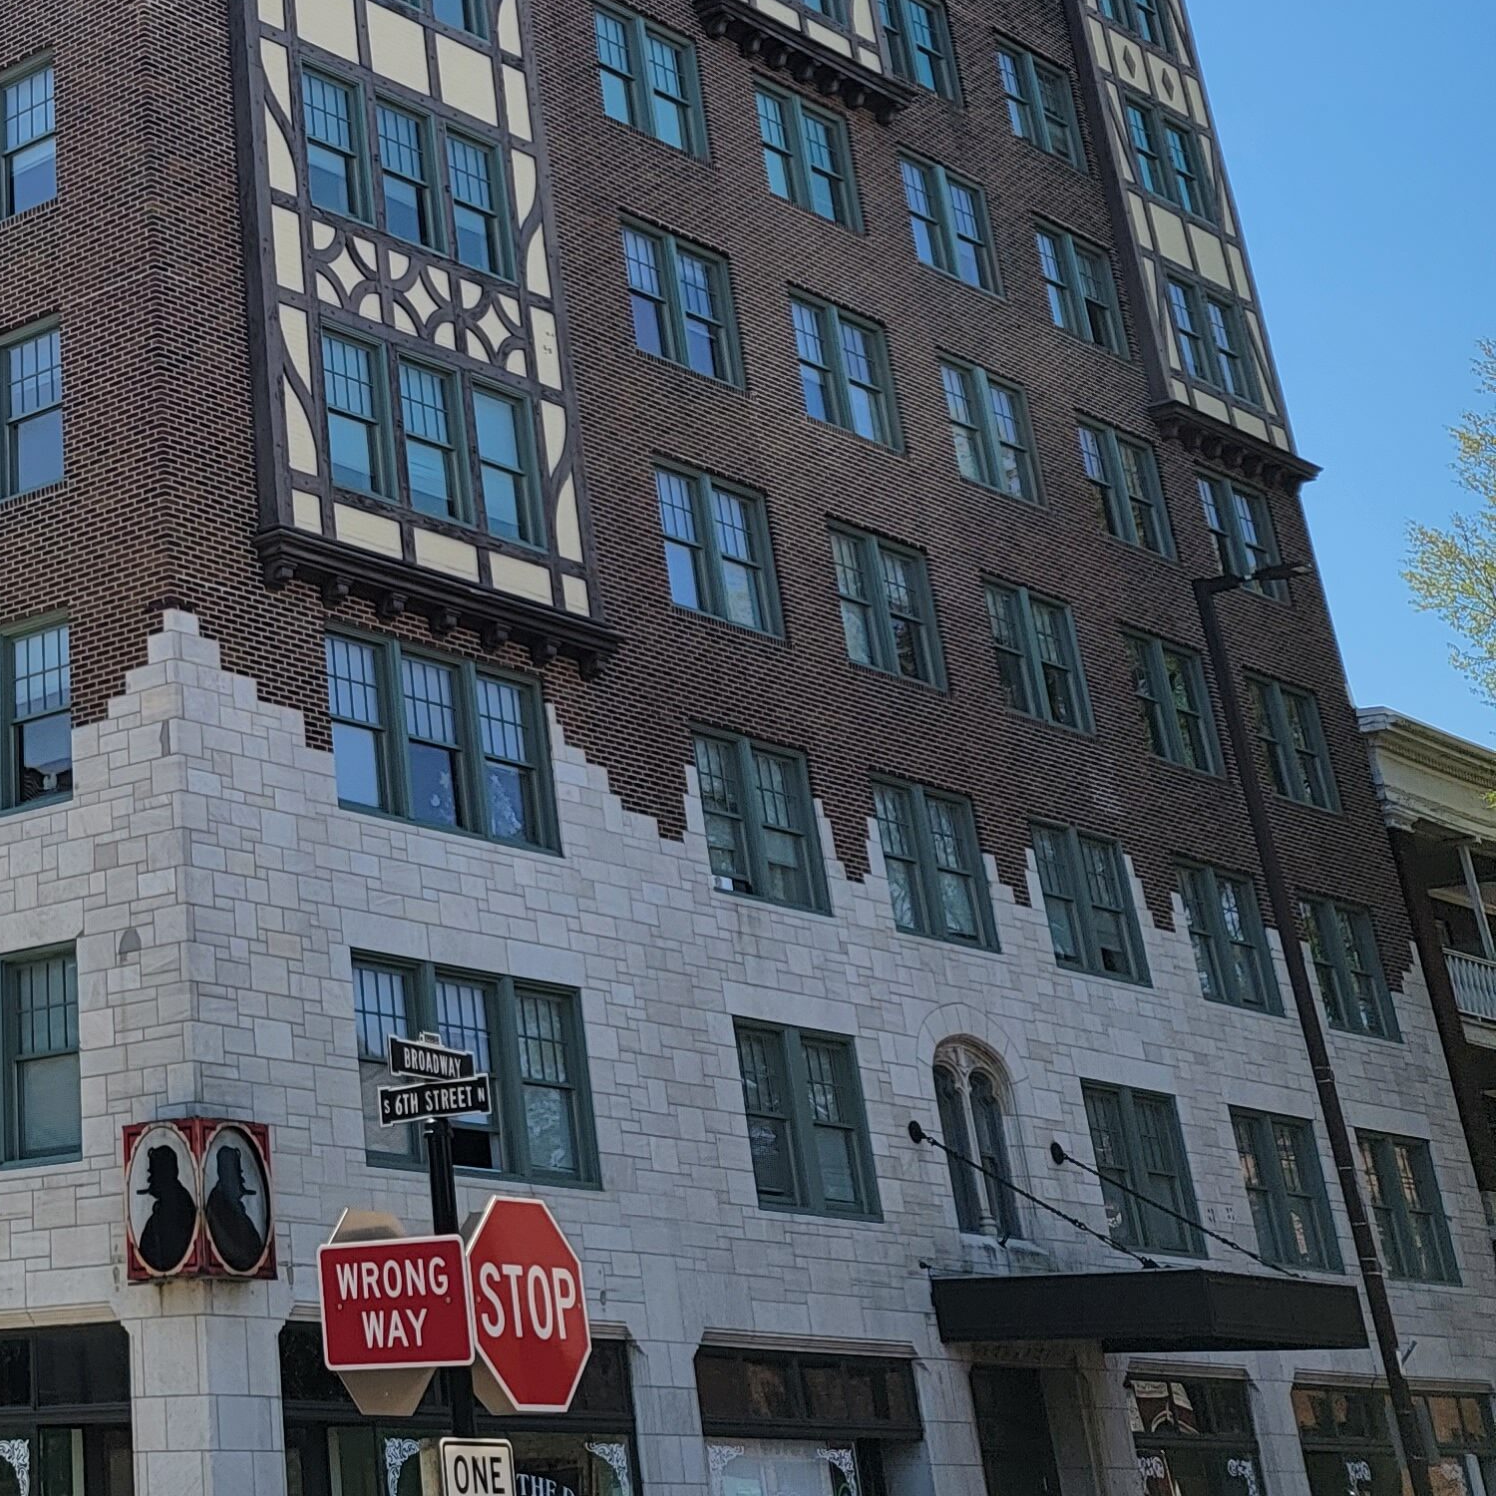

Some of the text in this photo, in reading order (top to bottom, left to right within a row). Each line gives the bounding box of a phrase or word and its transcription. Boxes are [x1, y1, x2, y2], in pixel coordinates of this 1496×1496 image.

[404, 1047, 461, 1078] BROADWAY
[384, 1086, 486, 1115] S 6TH STREET N
[336, 1256, 449, 1301] WRONG
[479, 1261, 577, 1341] STOP
[361, 1308, 428, 1349] WAY
[454, 1454, 505, 1495] ONE
[516, 1473, 558, 1496] THE
